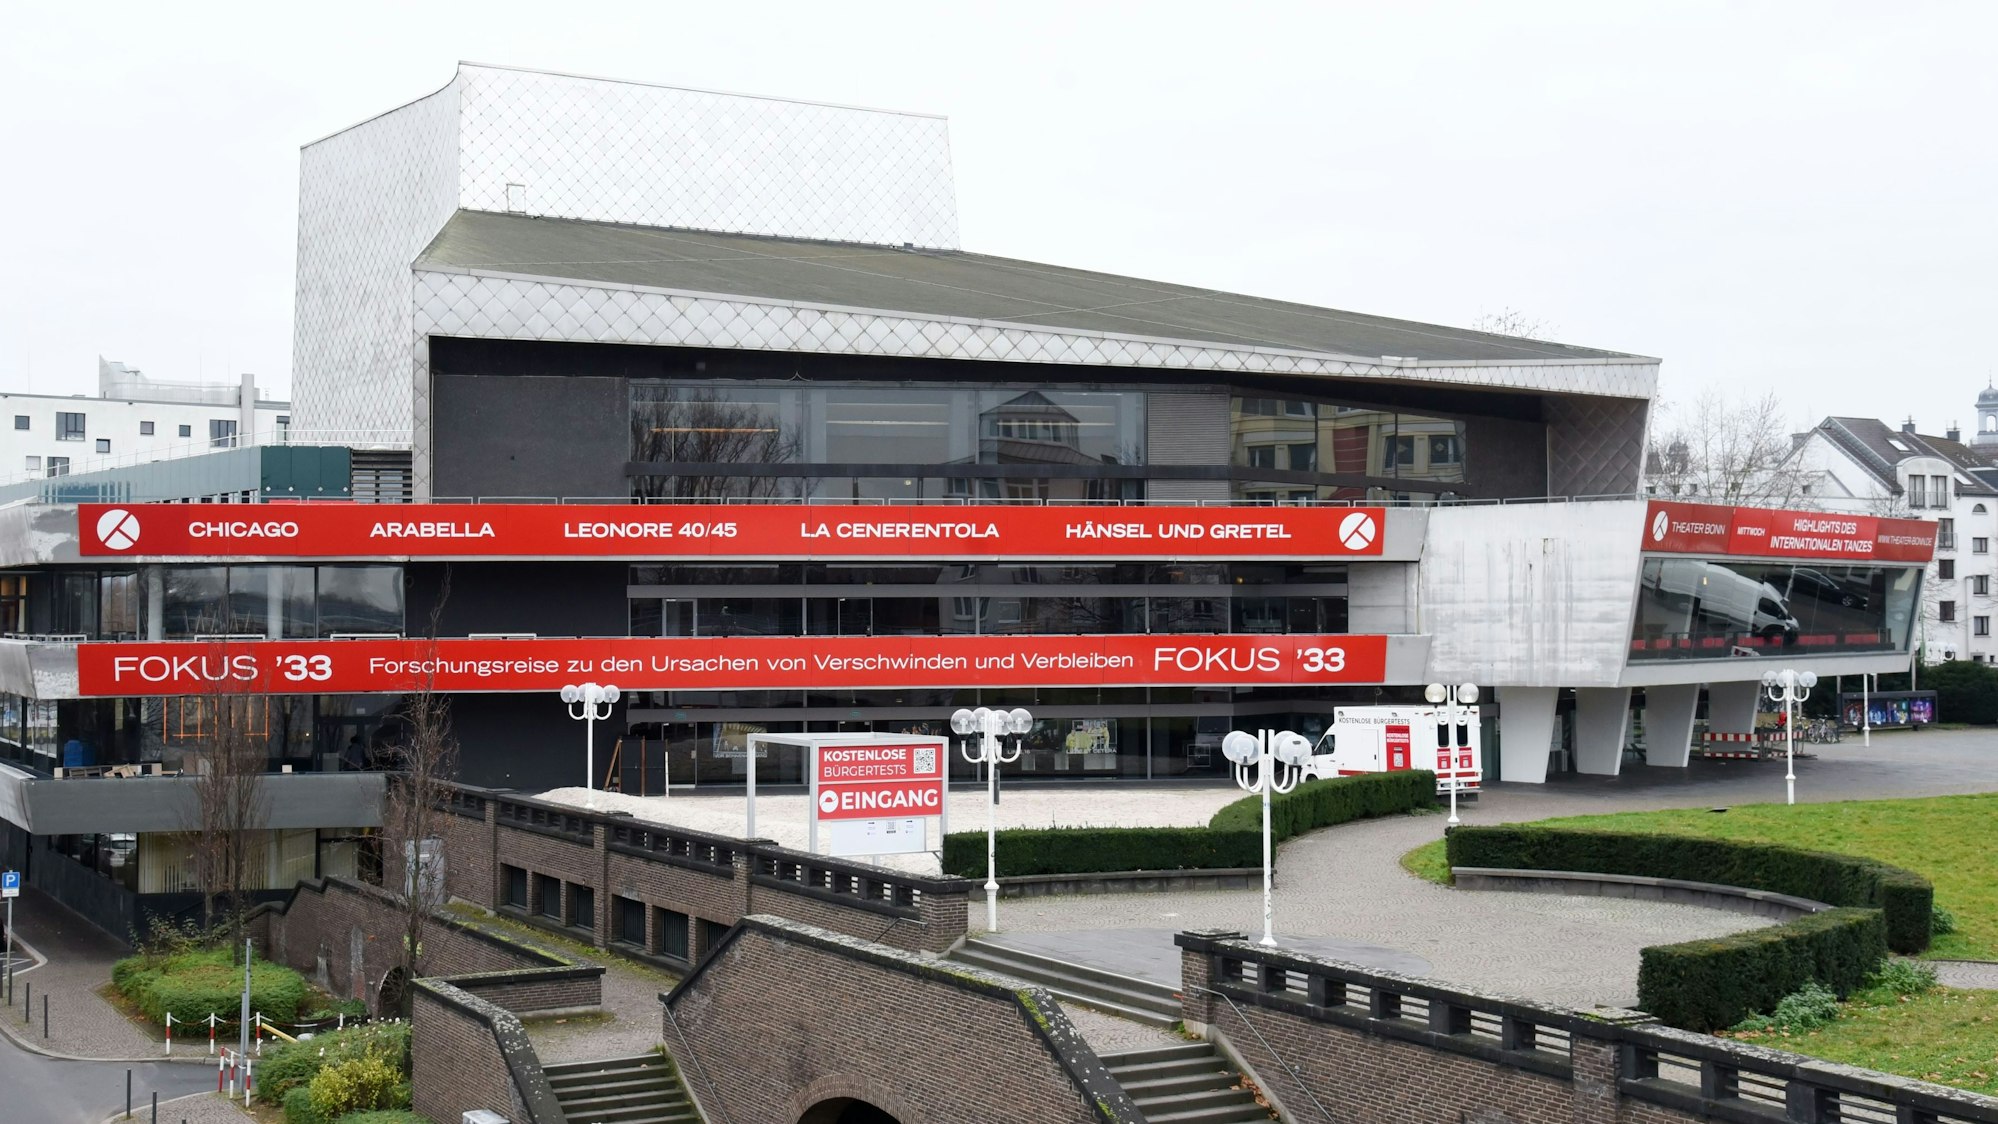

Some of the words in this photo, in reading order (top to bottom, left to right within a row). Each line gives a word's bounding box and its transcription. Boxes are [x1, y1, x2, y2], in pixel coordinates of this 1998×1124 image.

[188, 521, 299, 538] CHICAGO
[369, 522, 496, 538] ARABELLA
[564, 522, 673, 539] LEONORE
[678, 522, 738, 539] 40/45
[800, 522, 831, 538] LA
[836, 522, 1000, 539] CENERENTOLA
[1065, 519, 1153, 539] HÄNSEL
[1158, 523, 1205, 539] UND
[1209, 523, 1292, 539] GRETEL
[1672, 521, 1704, 534] THEATER
[1704, 523, 1726, 535] BONN
[1737, 526, 1766, 537] MITTWOCH
[1793, 518, 1841, 533] HIGHLIGHTS
[1841, 522, 1857, 535] DES
[1770, 536, 1843, 551] INTERNATIONALEN
[1843, 540, 1873, 553] TANZES
[369, 657, 559, 677] Forschungsreise
[567, 660, 593, 673] zu
[600, 656, 643, 673] den
[651, 655, 759, 672] Ursachen
[766, 658, 806, 671] von
[814, 654, 967, 670] Verschwinden
[975, 654, 1015, 669] und
[1021, 654, 1134, 669] Verbleiben
[1154, 646, 1281, 672] FOKUS
[114, 655, 259, 682] FOKUS
[1339, 717, 1372, 725] KOSTENLOSE
[1373, 716, 1411, 725] BÜRGERTESTS
[824, 749, 907, 762] KOSTENLOSE
[824, 764, 907, 777] BÜRGERTESTS
[841, 788, 938, 810] EINGANG
[6, 874, 16, 887] P
